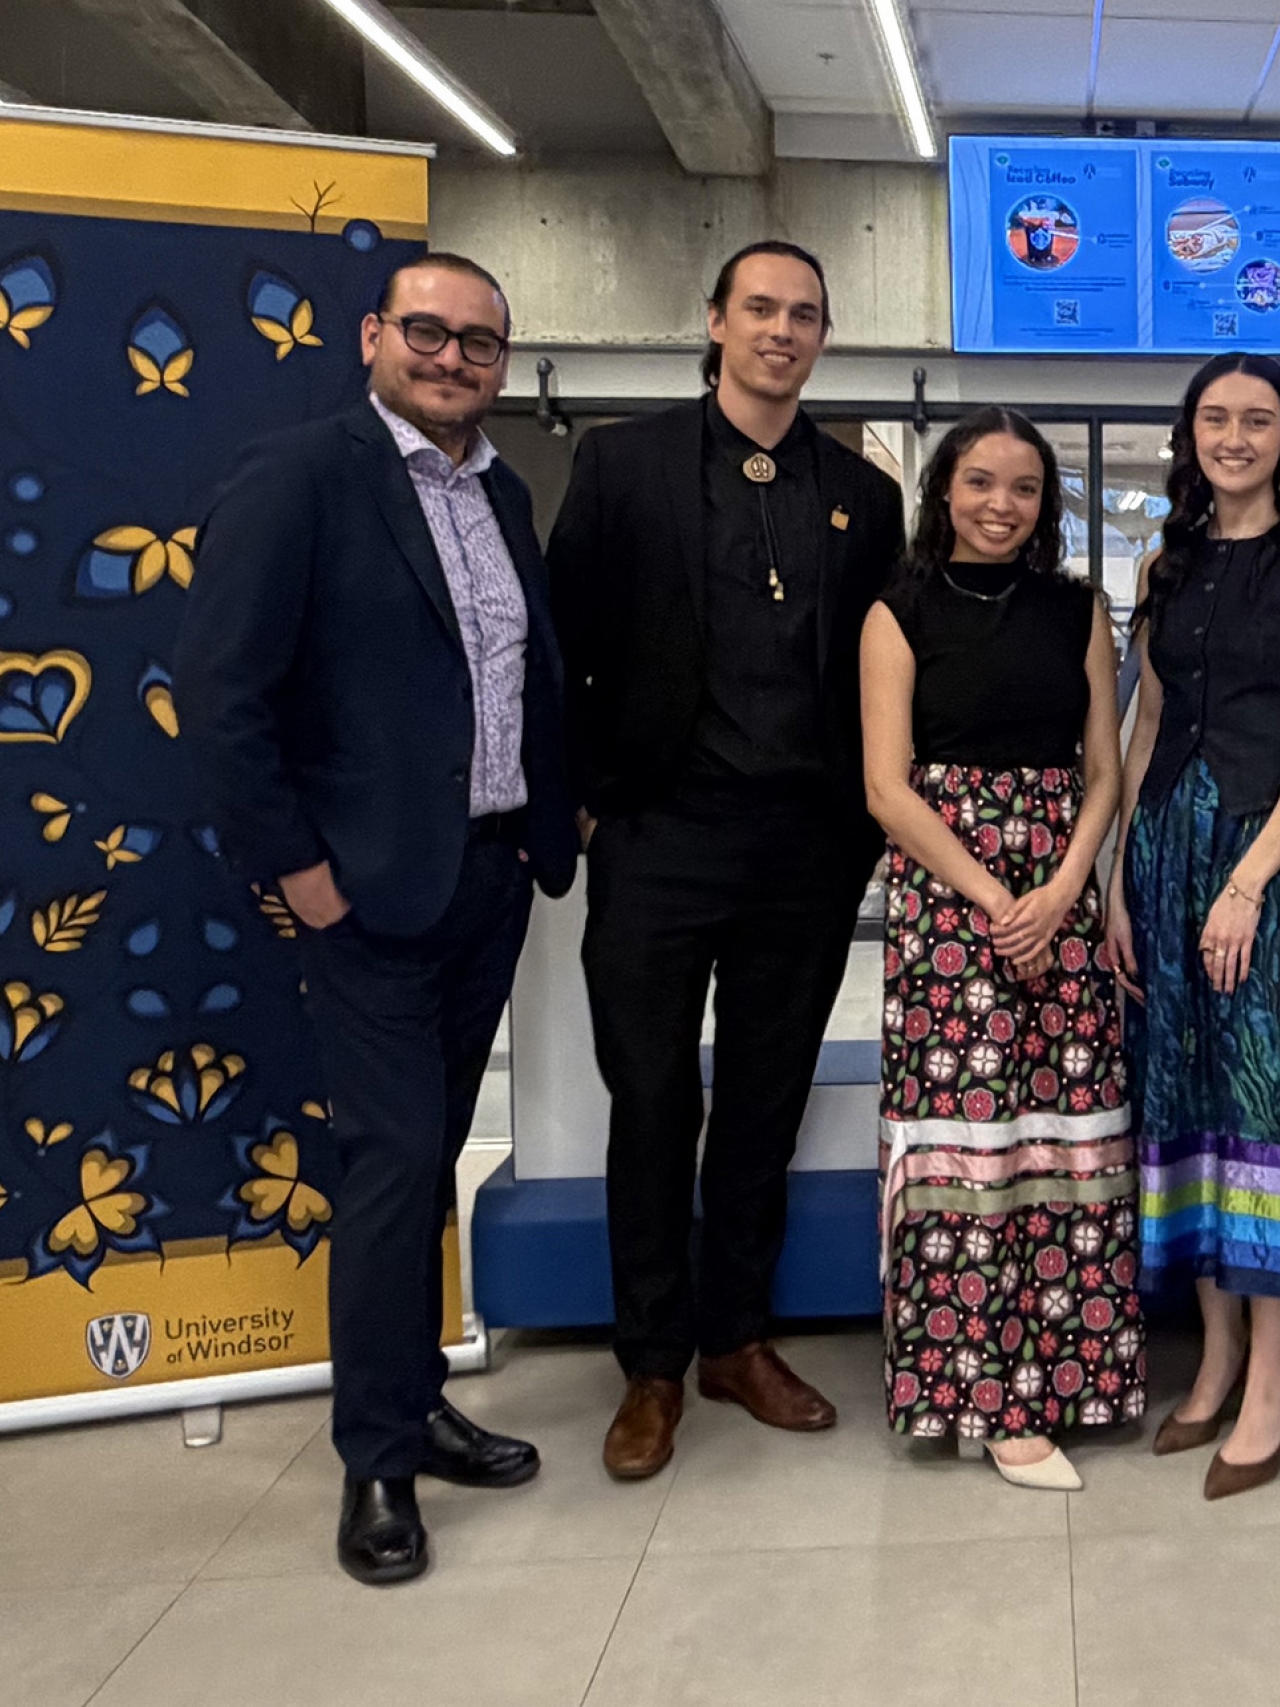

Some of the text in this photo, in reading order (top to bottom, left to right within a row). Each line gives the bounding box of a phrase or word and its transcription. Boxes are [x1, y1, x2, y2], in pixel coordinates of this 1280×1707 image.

[164, 1306, 295, 1340] University
[166, 1332, 295, 1364] of Windsor
